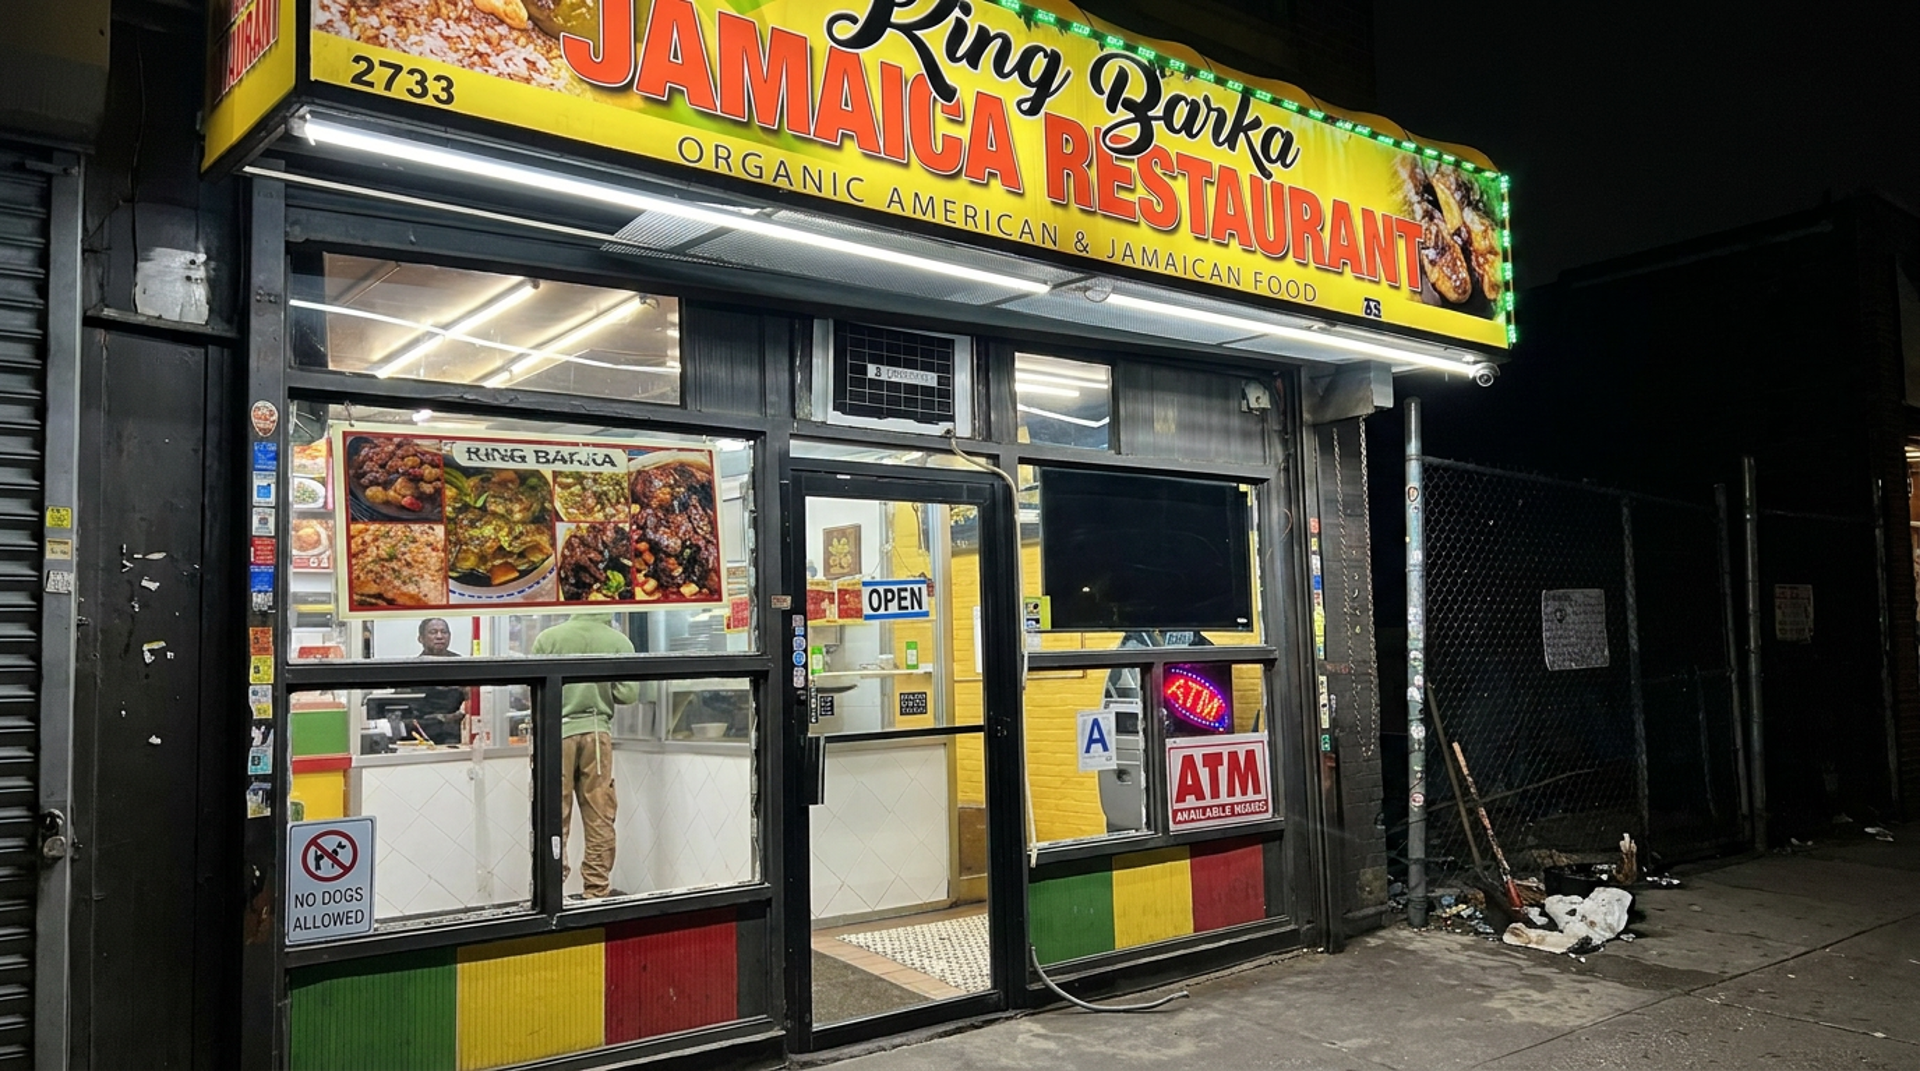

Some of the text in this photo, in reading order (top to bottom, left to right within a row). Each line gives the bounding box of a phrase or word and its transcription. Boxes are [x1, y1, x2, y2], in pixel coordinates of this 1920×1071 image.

[350, 54, 455, 105] 2733
[826, 0, 1301, 180] King Barka
[561, 0, 1423, 292] JAMAICA RESTAURANT
[678, 136, 1318, 302] ORGANIC AMERICAN & JAMAICAN FOOD
[868, 586, 923, 612] OPEN
[1167, 679, 1221, 721] ATM
[1084, 717, 1110, 754] A
[1175, 749, 1262, 804] ATM
[294, 886, 364, 908] NO DOGS
[293, 909, 365, 932] ALLOWED
